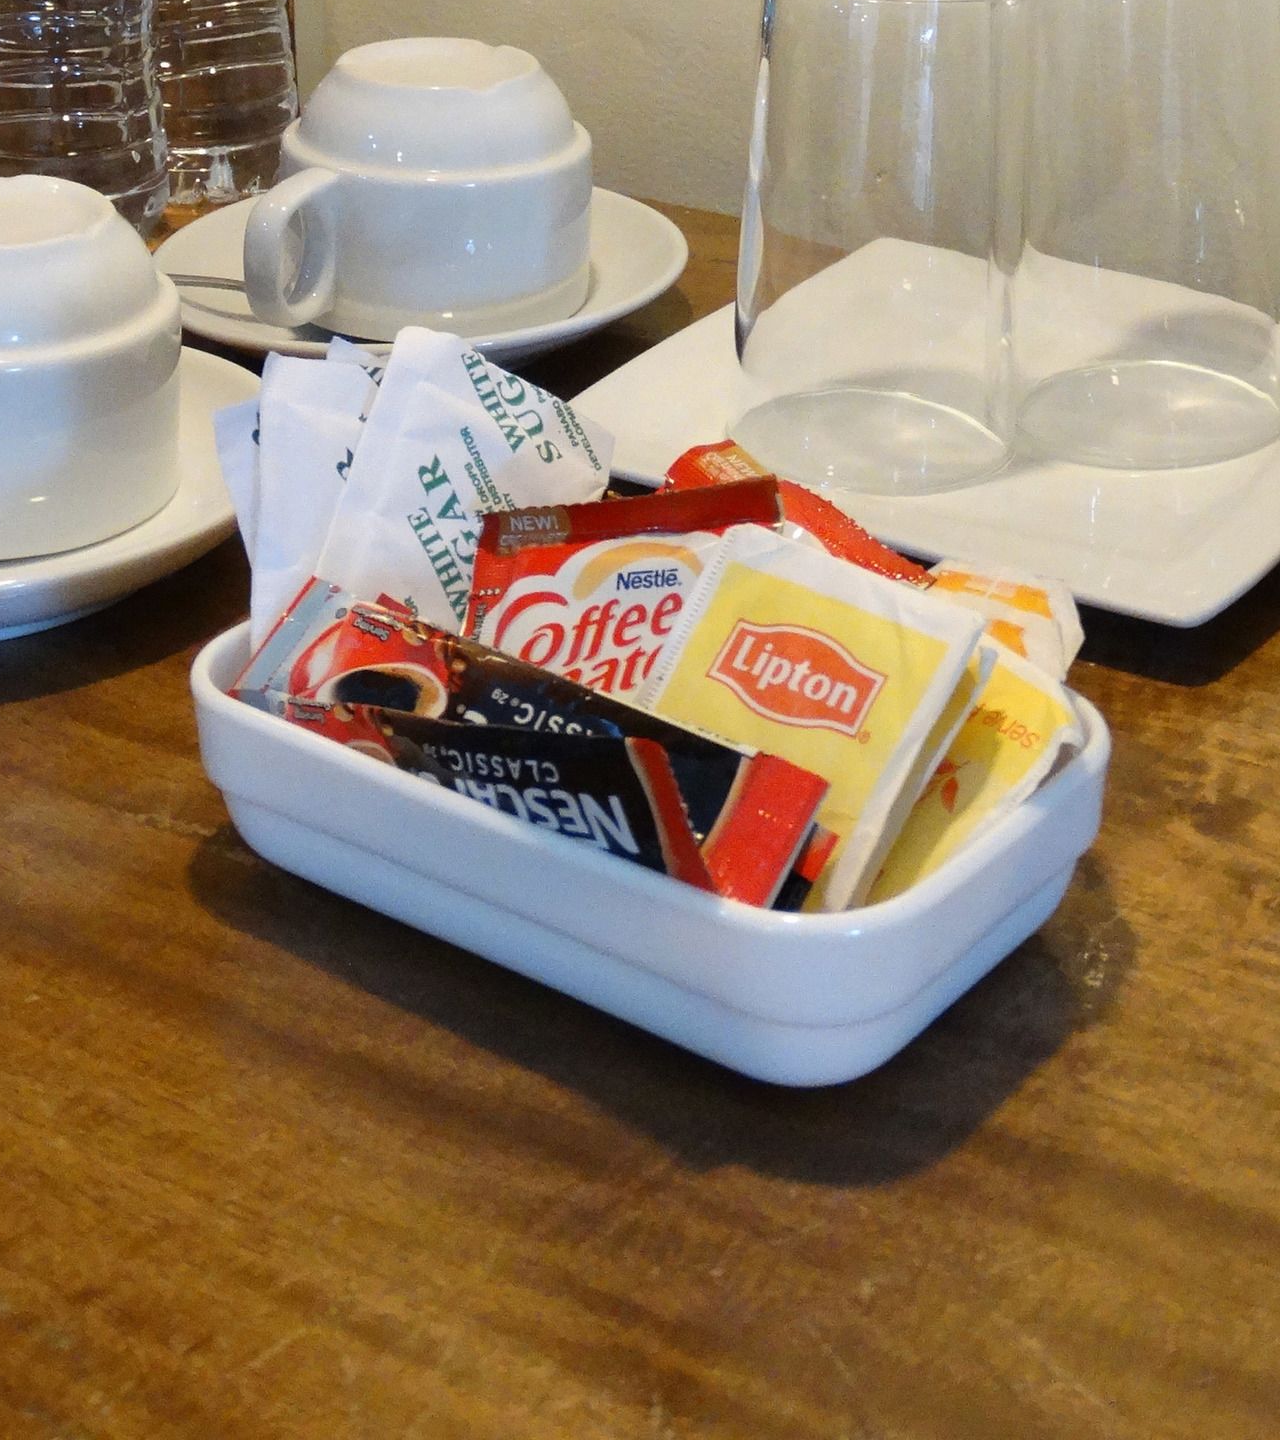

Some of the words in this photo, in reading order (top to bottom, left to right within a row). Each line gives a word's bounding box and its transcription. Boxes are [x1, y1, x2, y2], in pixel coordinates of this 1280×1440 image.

[461, 353, 527, 454] WHITE
[460, 426, 503, 509] DISTRIBUTOR
[417, 454, 480, 580] GAR
[509, 514, 559, 532] NEW!
[407, 507, 470, 625] WHITE
[617, 568, 679, 591] Nestlé
[494, 591, 684, 668] Coffee
[732, 633, 859, 715] Lipton
[446, 749, 561, 783] CLASSIC
